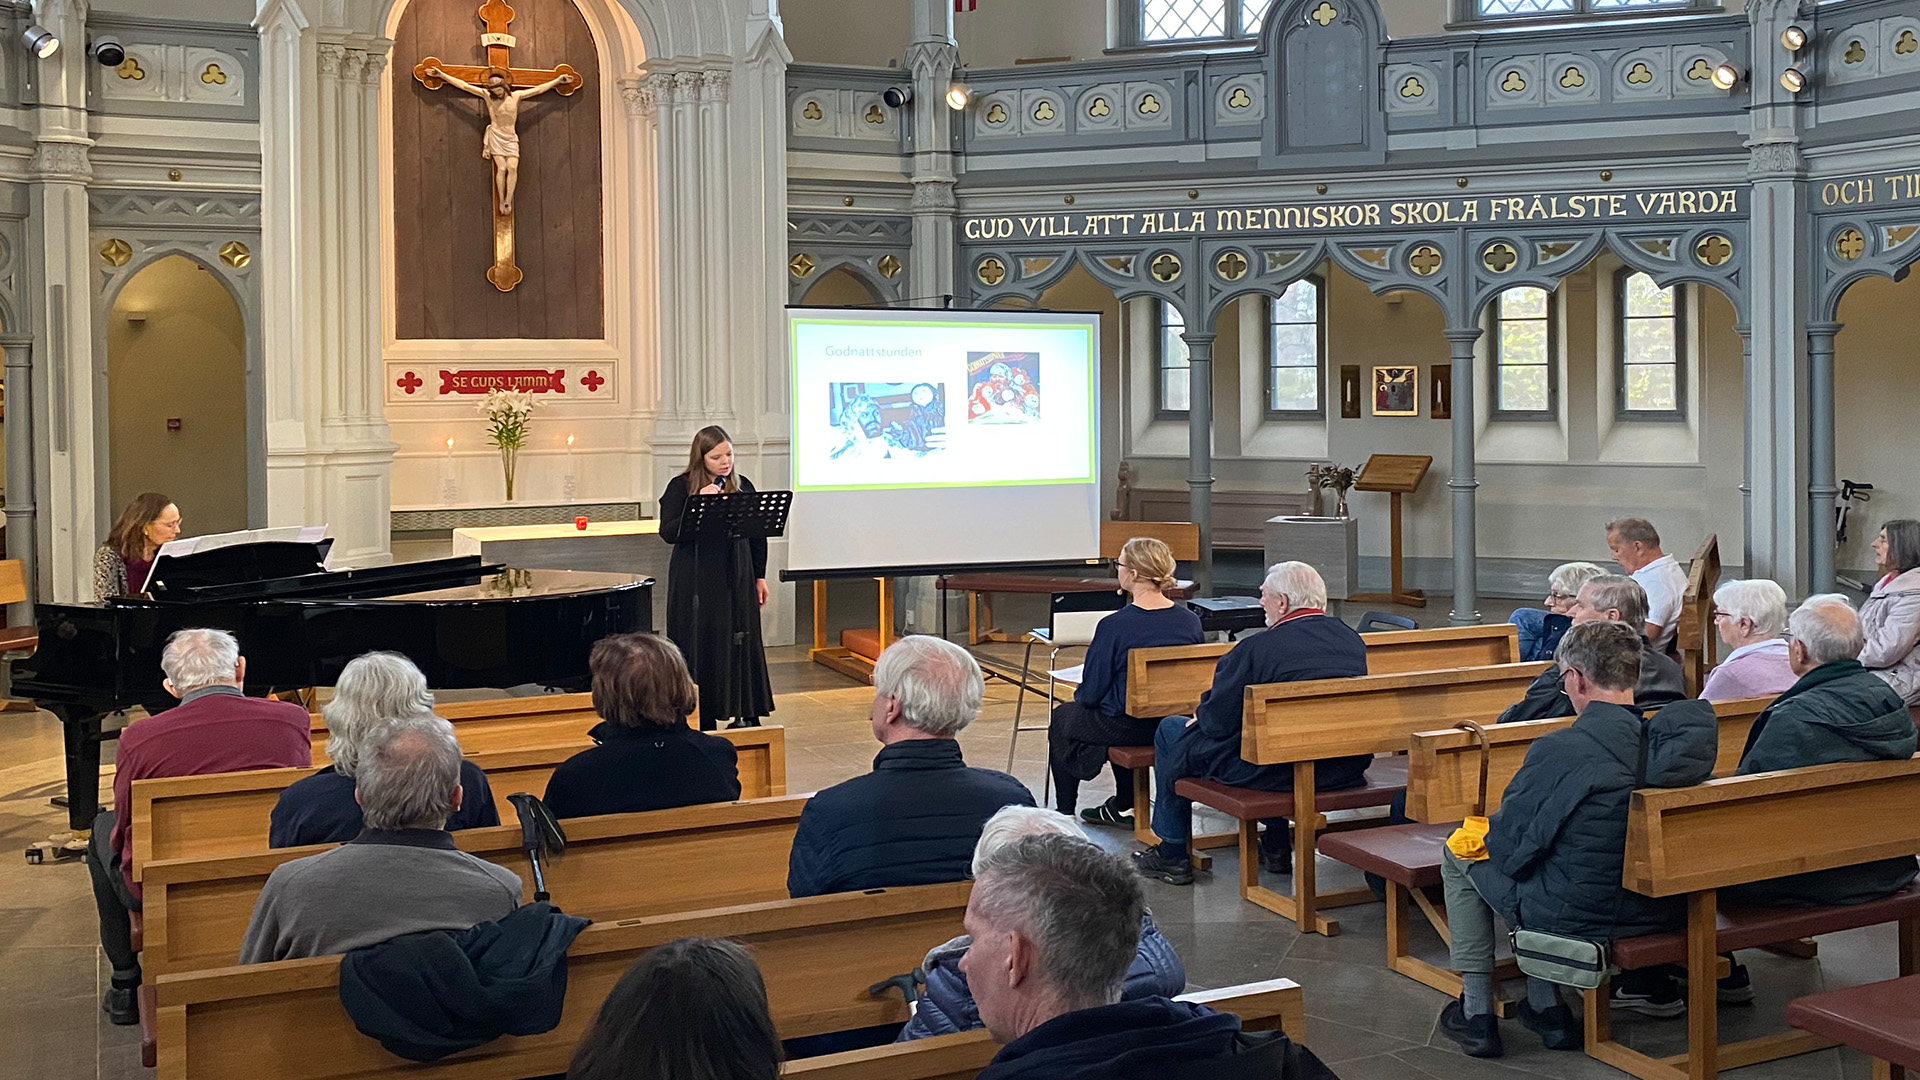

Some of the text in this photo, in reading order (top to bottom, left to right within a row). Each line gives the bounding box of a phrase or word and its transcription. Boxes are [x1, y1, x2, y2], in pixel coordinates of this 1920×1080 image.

[1821, 178, 1875, 206] OCH
[964, 189, 1738, 240] GUD VILL ATT ALLA MENNISKOR SKOLA FRÄLSTE VARDA
[825, 344, 922, 358] Godnattstunden
[452, 376, 468, 388] SE
[470, 376, 504, 388] GUDS
